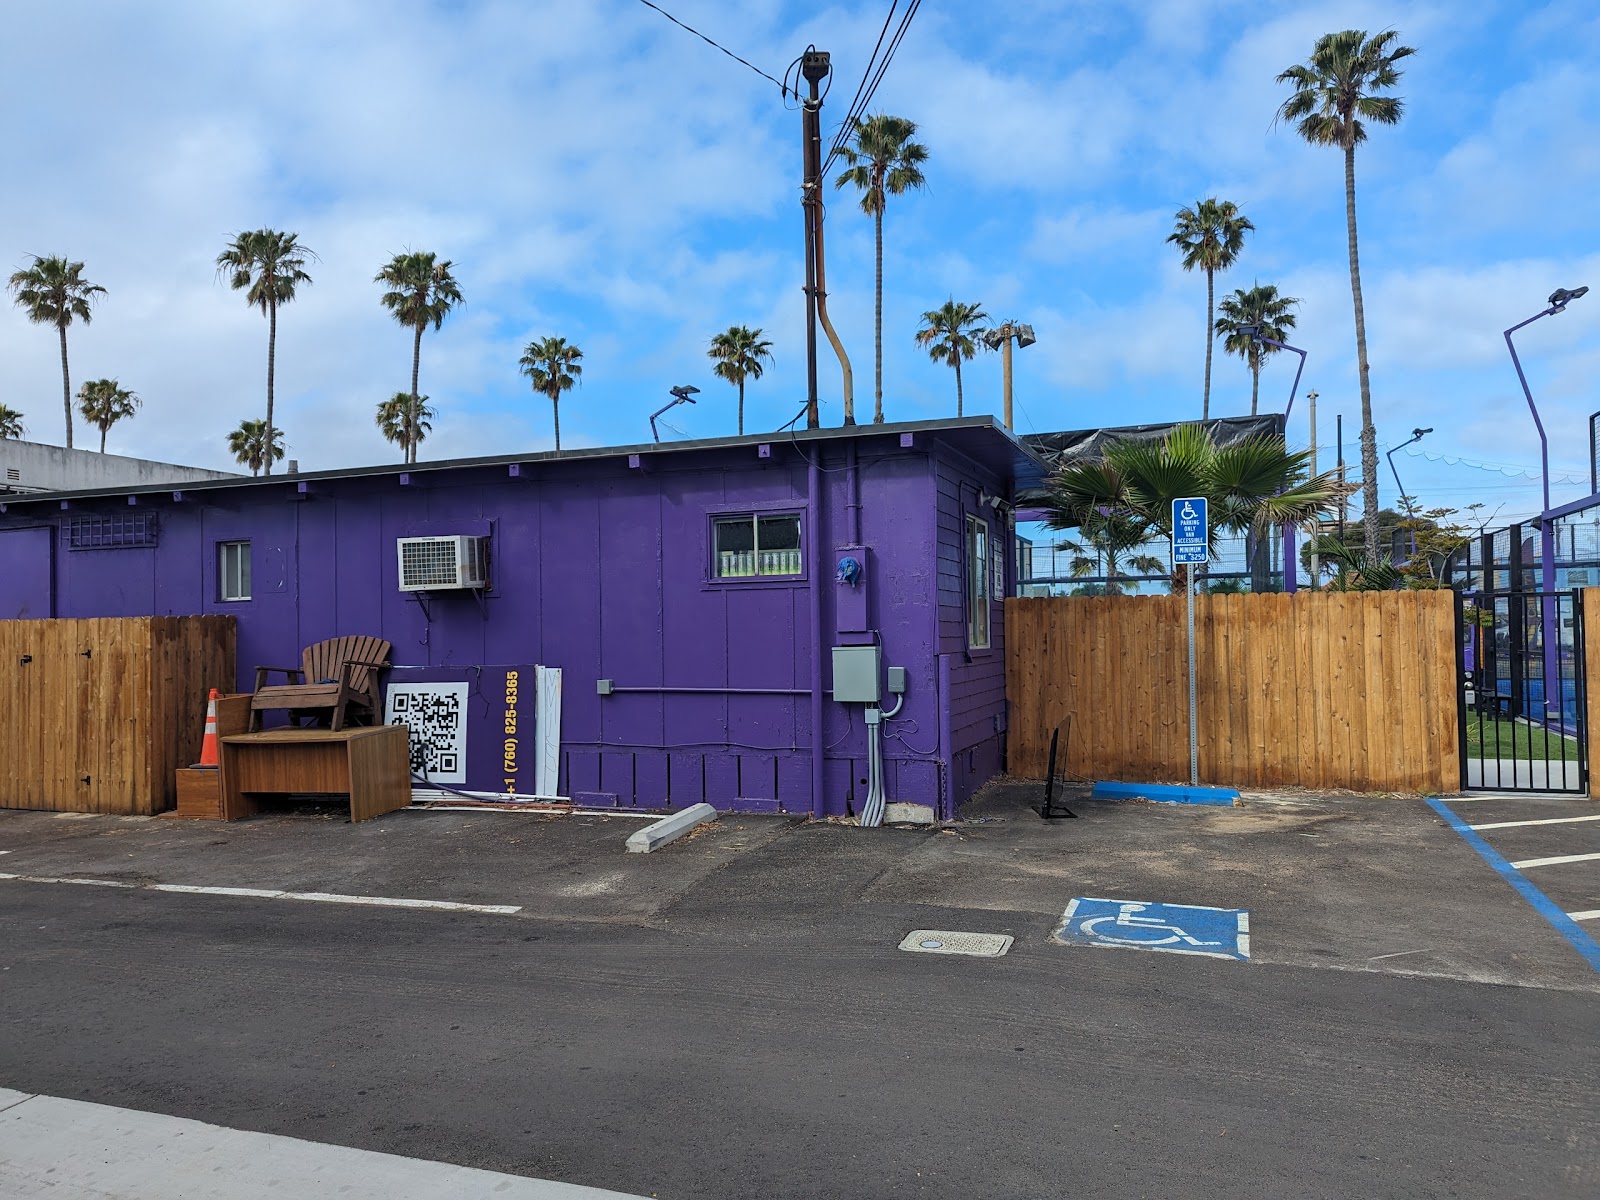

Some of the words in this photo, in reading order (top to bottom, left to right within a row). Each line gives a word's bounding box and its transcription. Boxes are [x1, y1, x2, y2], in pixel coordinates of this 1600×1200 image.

[1179, 546, 1202, 554] MINIMUM
[504, 670, 519, 734] 825-8365
[503, 738, 519, 773] (760)
[503, 778, 516, 795] +1
